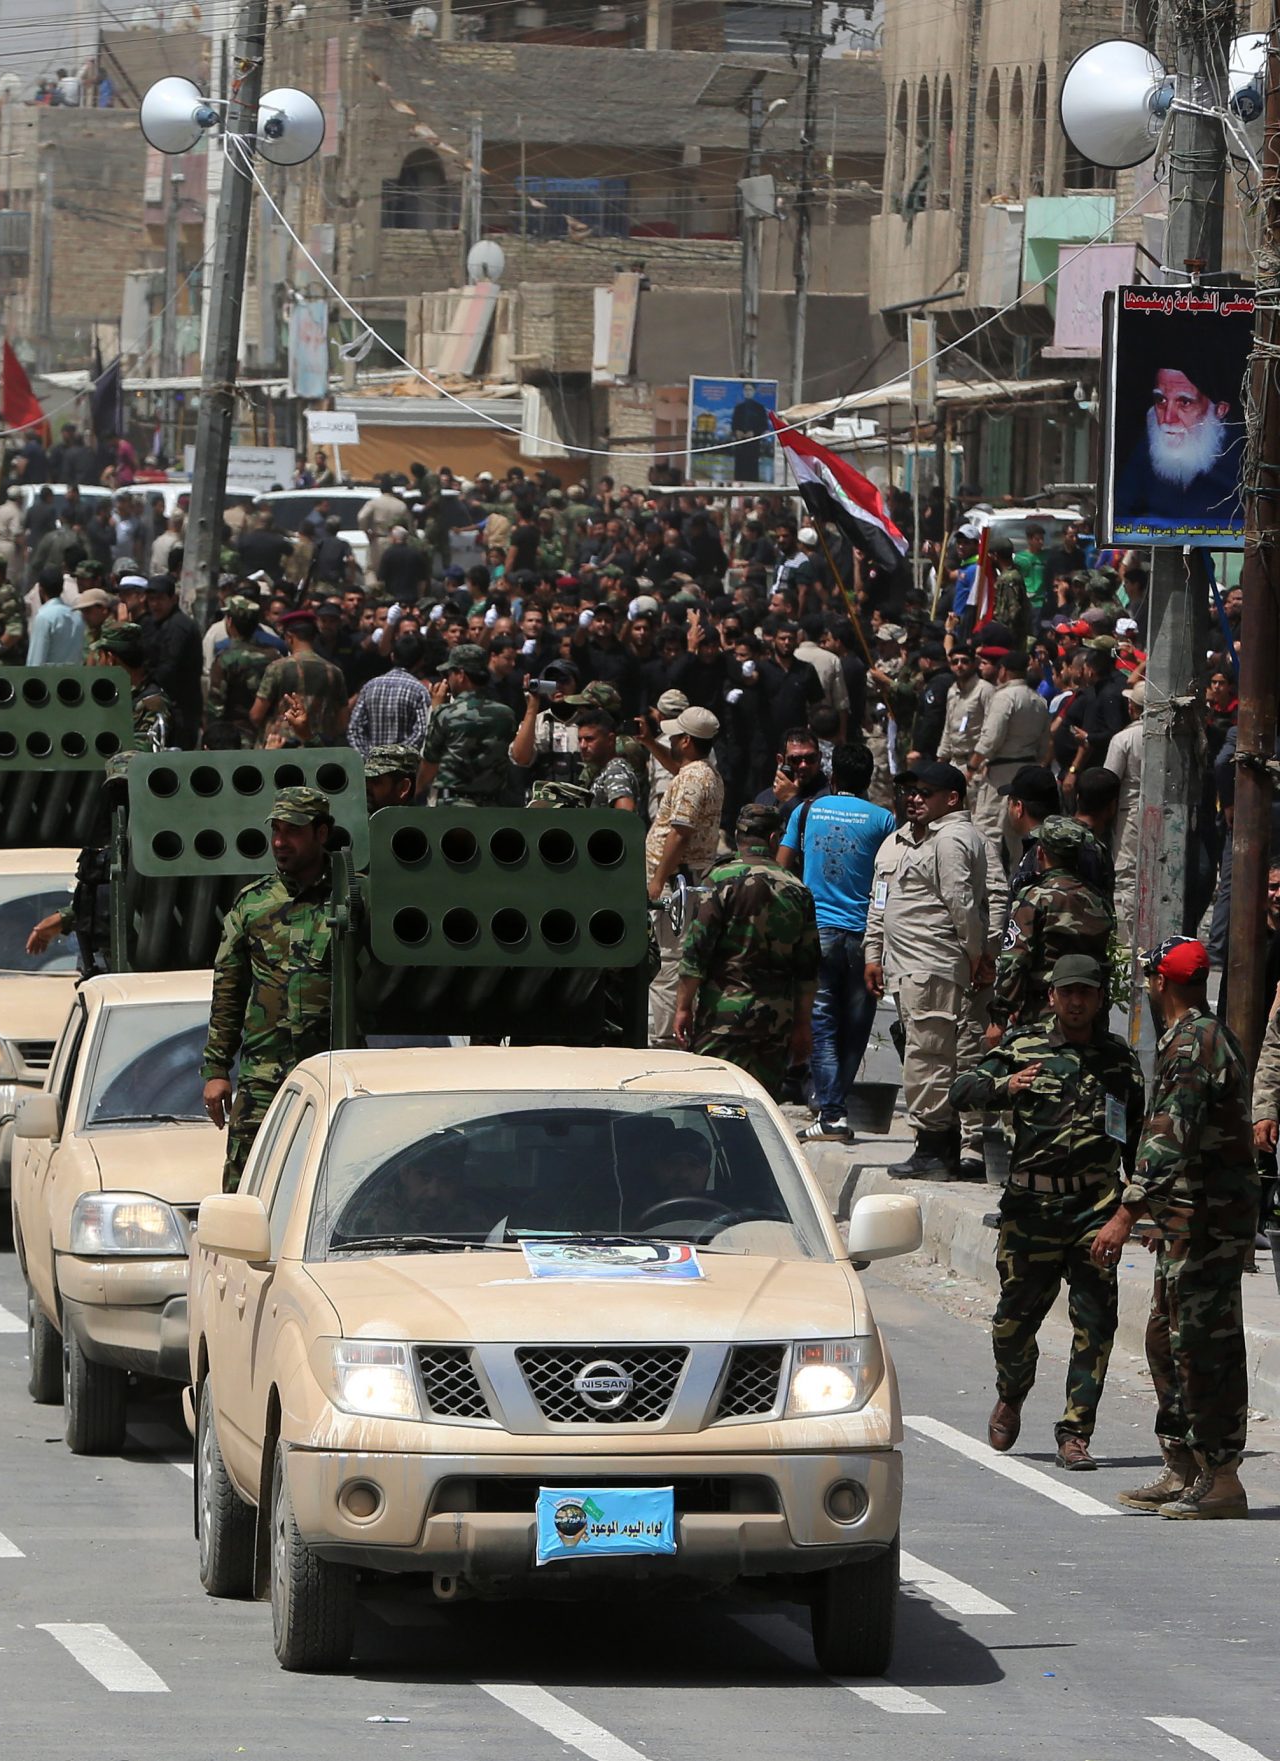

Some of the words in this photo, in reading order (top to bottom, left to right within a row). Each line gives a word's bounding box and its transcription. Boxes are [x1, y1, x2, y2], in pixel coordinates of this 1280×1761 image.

[1124, 290, 1173, 315] ومنبعها
[1174, 291, 1219, 315] الشجاعة
[581, 1380, 628, 1389] NISSAN
[590, 1520, 619, 1537] الموعود
[621, 1520, 645, 1537] اليوم
[646, 1520, 663, 1537] لواء
